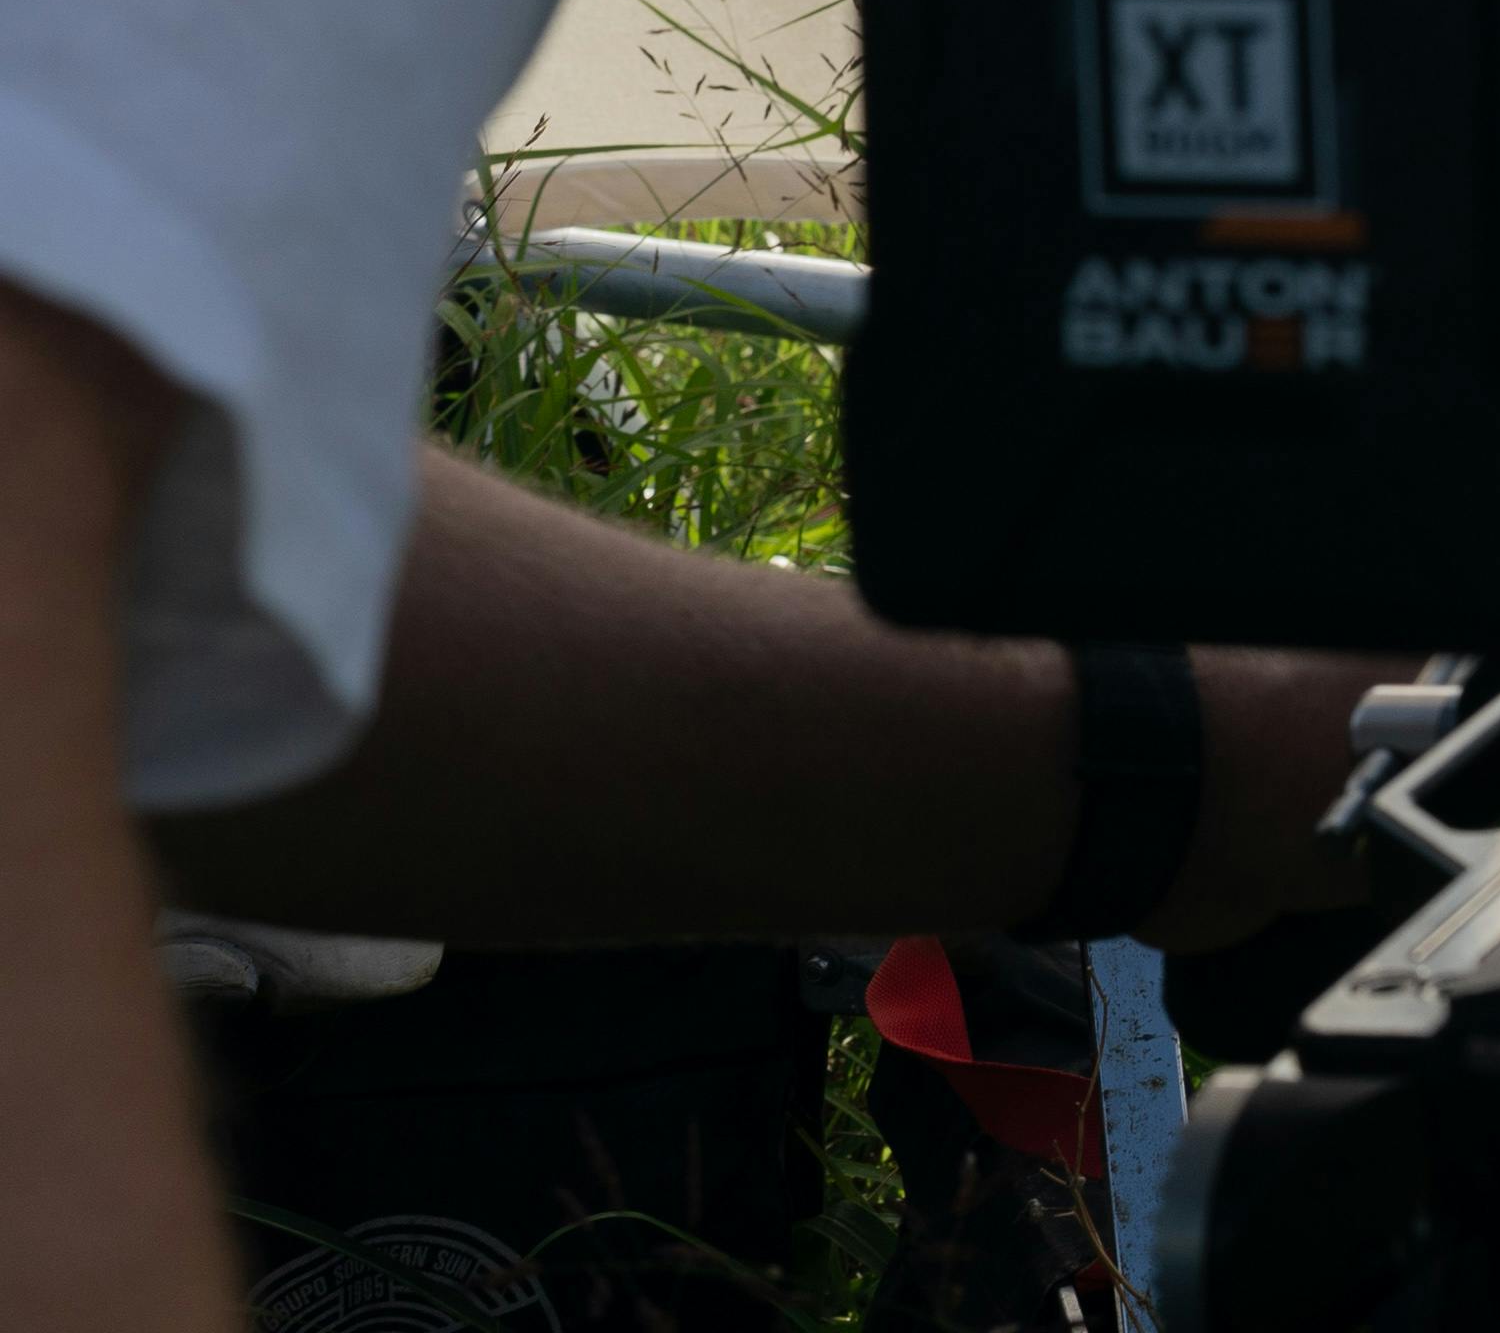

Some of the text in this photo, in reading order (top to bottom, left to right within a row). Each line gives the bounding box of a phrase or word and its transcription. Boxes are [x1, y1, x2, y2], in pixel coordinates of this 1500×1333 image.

[1144, 23, 1259, 112] XT
[1062, 254, 1372, 319] ANTON
[332, 1244, 428, 1284] SOUERN
[434, 1250, 472, 1284] SUN
[346, 1273, 385, 1309] 1995
